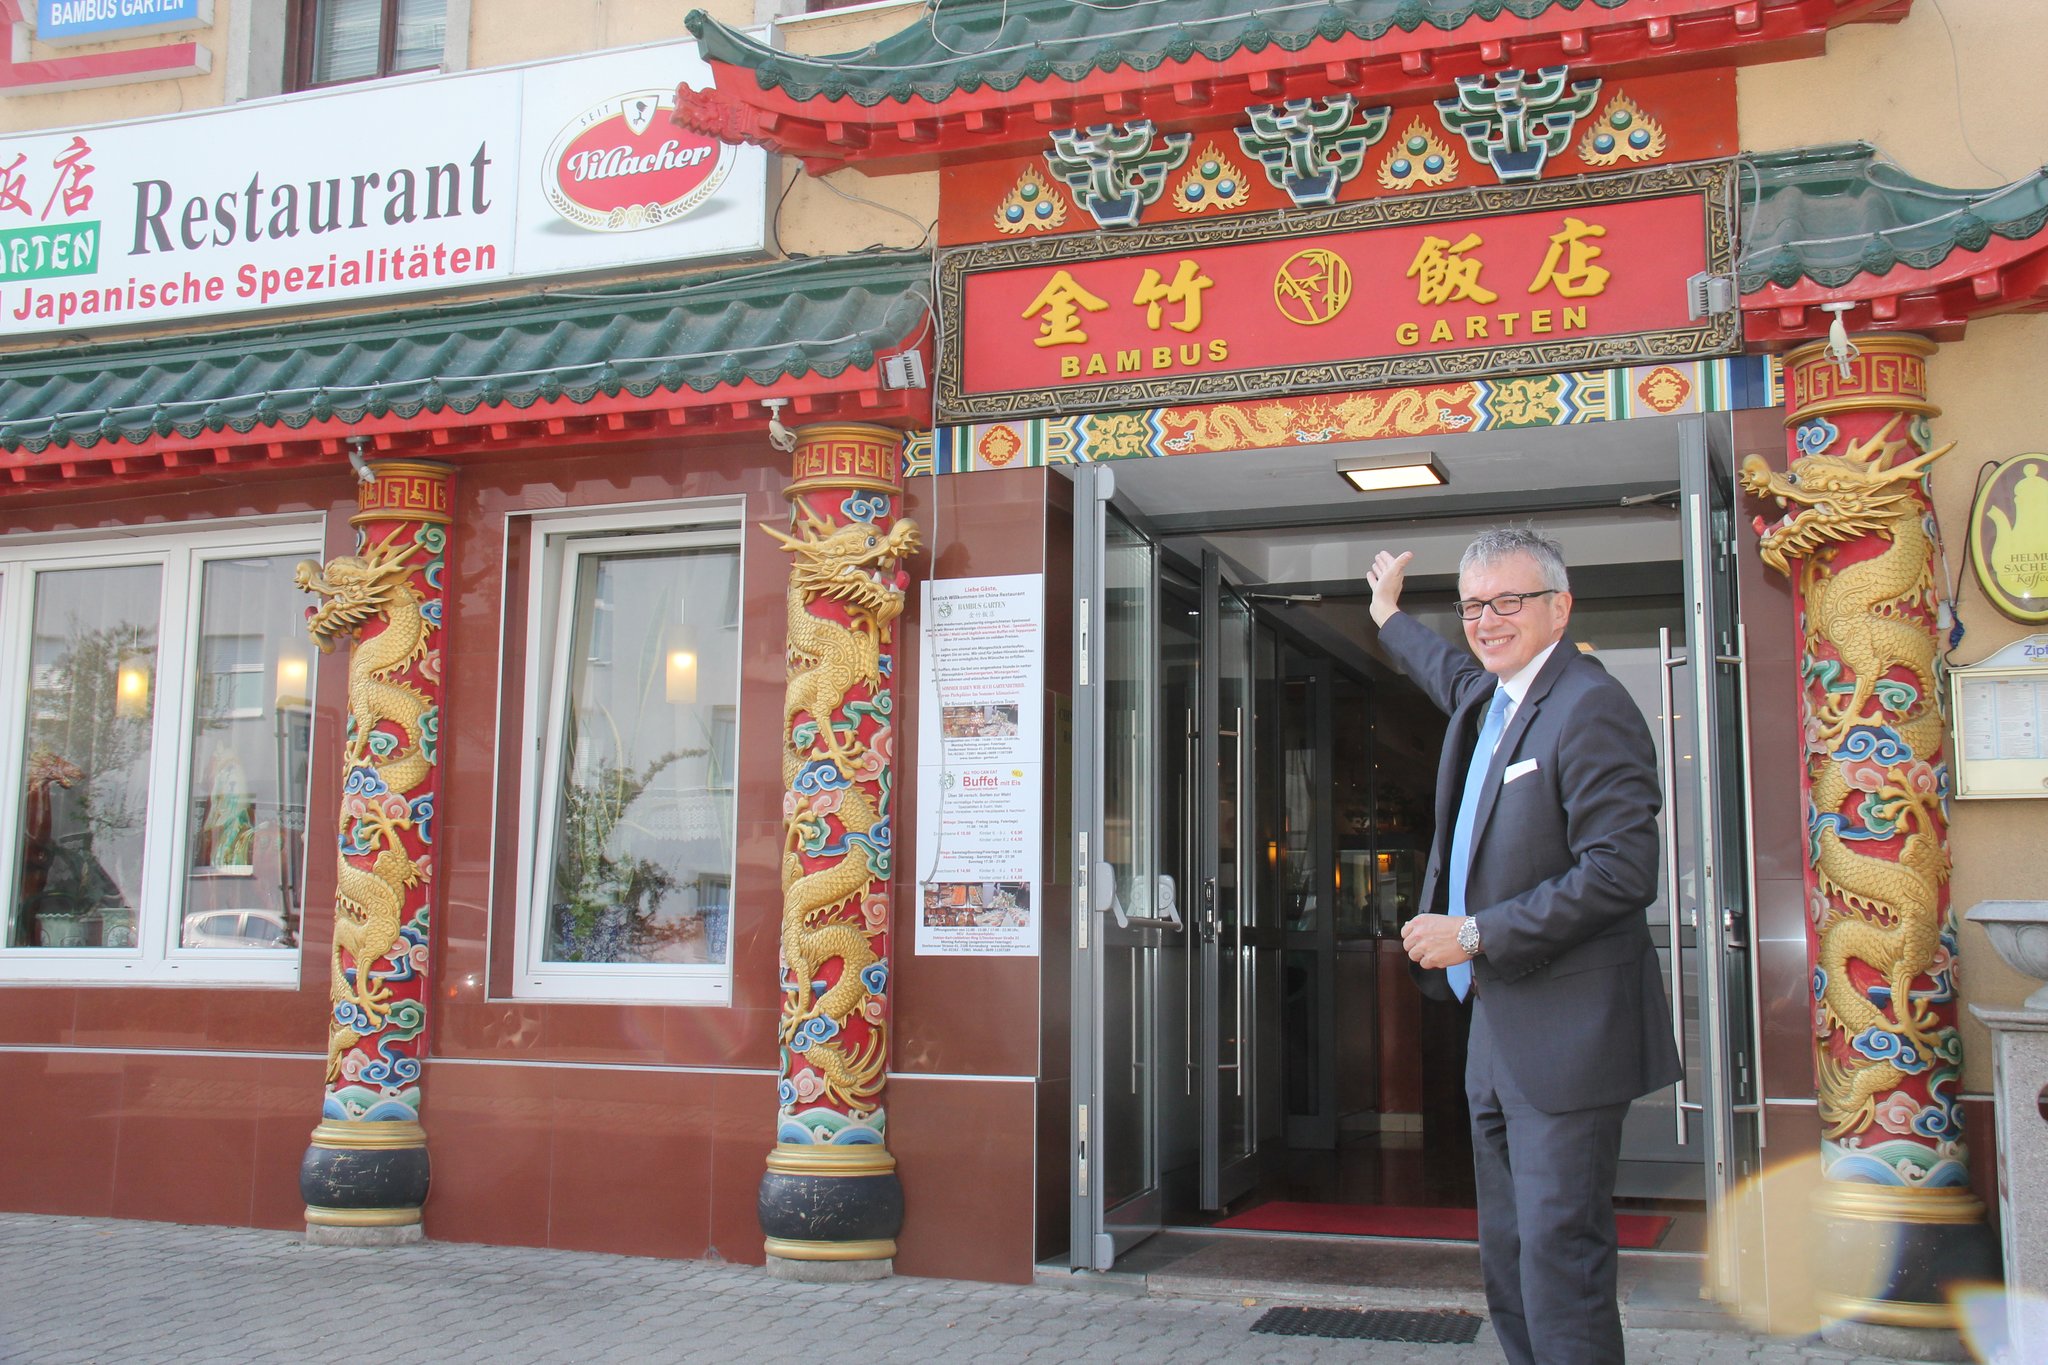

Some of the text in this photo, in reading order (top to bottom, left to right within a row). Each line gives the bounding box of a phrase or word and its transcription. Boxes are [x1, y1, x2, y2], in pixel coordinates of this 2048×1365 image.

[51, 0, 117, 25] BAMBUS
[580, 104, 610, 126] SEIT
[566, 139, 713, 182] Villacher
[128, 140, 492, 256] Restaurant
[13, 271, 225, 325] Japanische
[236, 241, 495, 304] Spezialitäten
[1021, 216, 1611, 348] 金竹 飯店
[1060, 305, 1588, 379] BAMBUS GARTEN
[963, 776, 999, 787] Buffet
